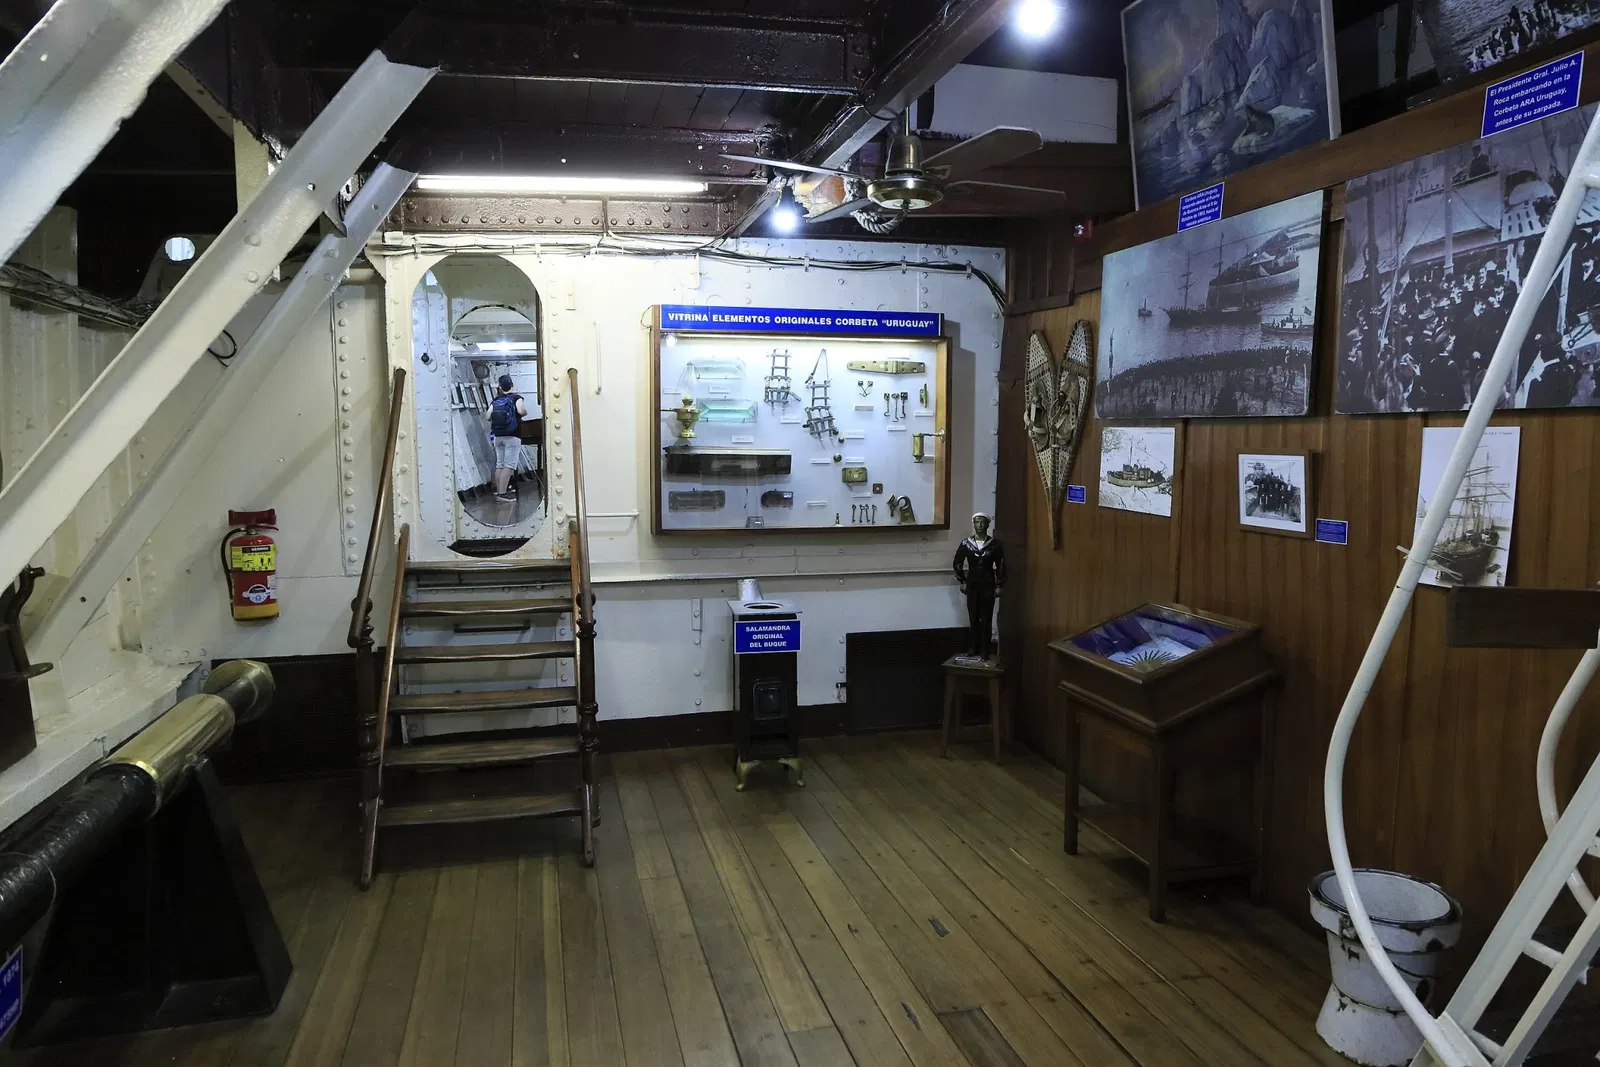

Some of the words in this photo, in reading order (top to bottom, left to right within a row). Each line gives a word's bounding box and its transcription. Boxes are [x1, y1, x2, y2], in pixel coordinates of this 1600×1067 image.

[1498, 77, 1531, 94] Presidente
[1534, 70, 1549, 80] Gral.
[1551, 63, 1568, 74] Julio
[1494, 96, 1509, 106] Roca
[1511, 80, 1552, 100] embarcando
[1494, 104, 1518, 116] Corbeta
[1520, 97, 1535, 108] ARA
[1536, 87, 1567, 102] Uruguay,
[1495, 116, 1512, 127] antes
[1533, 100, 1562, 114] zarpada.
[668, 312, 709, 322] VITRINA
[713, 314, 770, 324] ELEMENTOS
[774, 316, 832, 326] ORIGINALES
[835, 317, 878, 327] CORBETA
